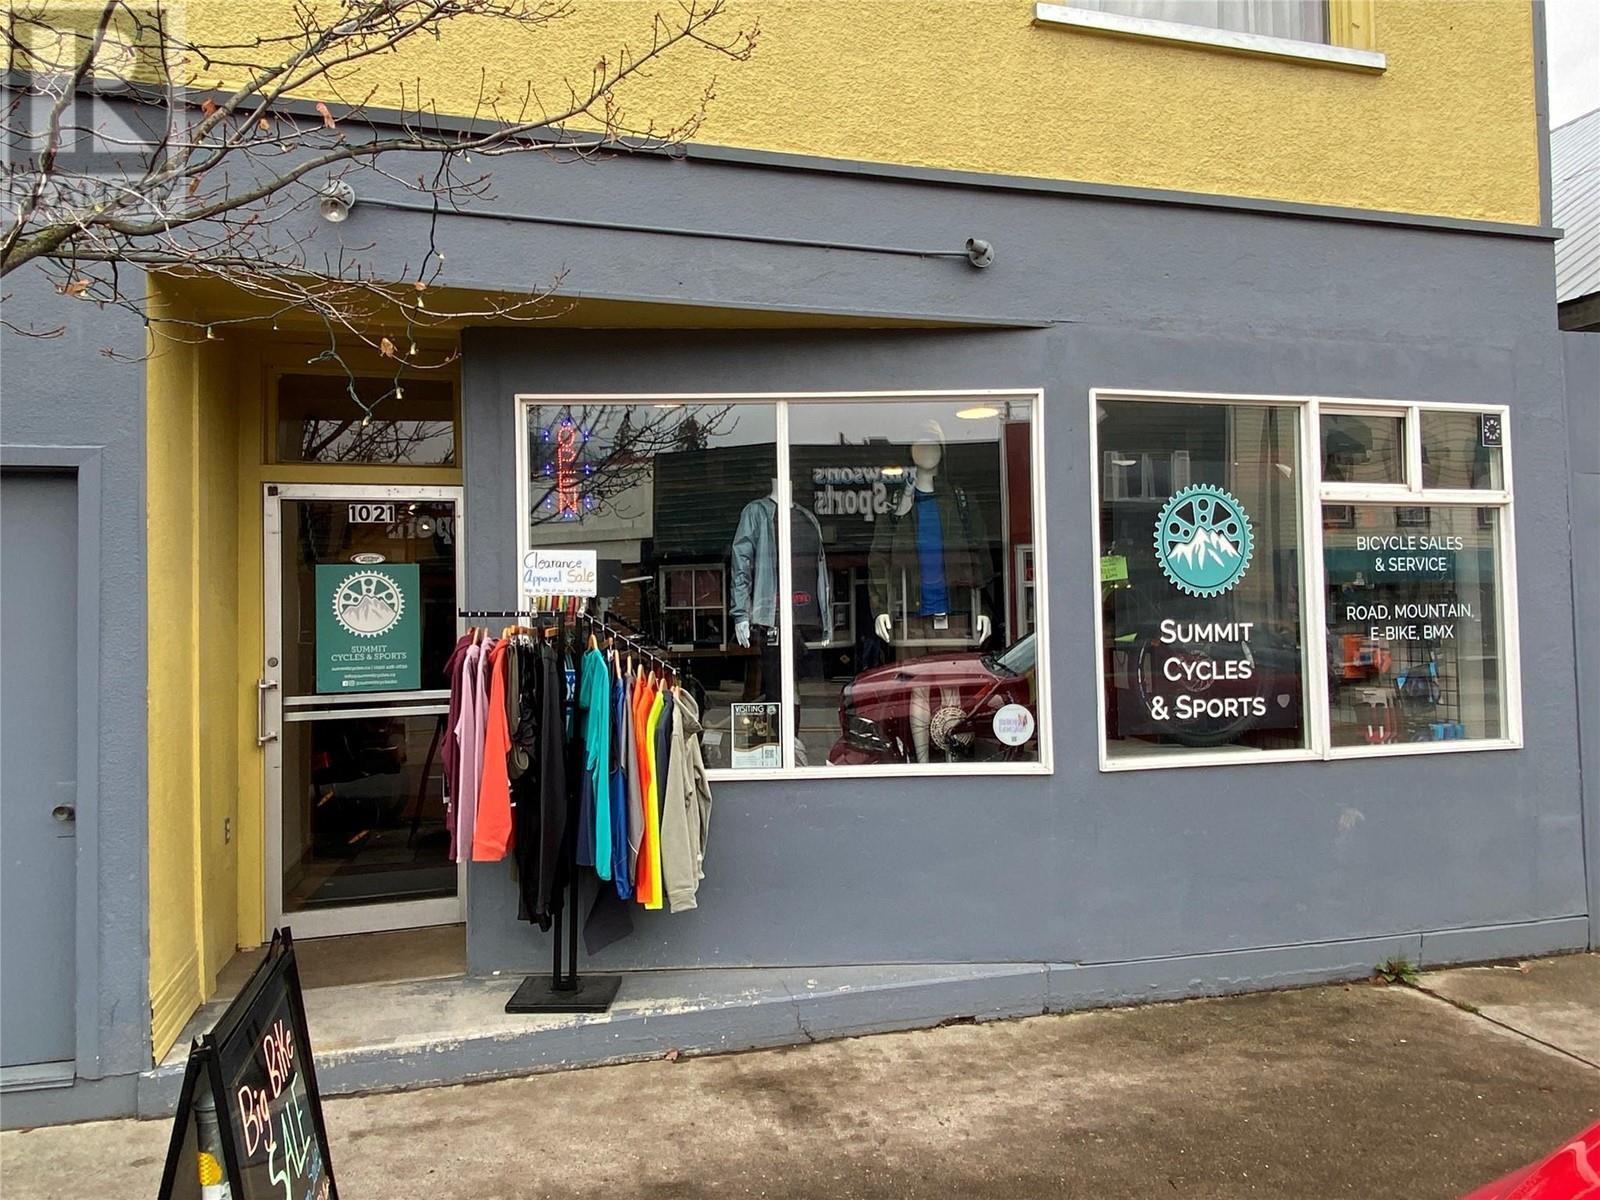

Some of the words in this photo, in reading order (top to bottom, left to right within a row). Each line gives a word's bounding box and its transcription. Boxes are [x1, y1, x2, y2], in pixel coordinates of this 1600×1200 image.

[557, 426, 578, 514] OPEN
[350, 505, 394, 522] 1021
[1356, 536, 1417, 551] BICYCLE
[1420, 536, 1464, 551] SALES
[523, 551, 583, 569] Clearance
[1375, 557, 1386, 572] &
[1388, 557, 1448, 572] SERVICE
[523, 569, 562, 587] Apparel
[566, 567, 595, 584] Sale
[1346, 605, 1392, 621] ROAD,
[1394, 603, 1475, 619] MOUNTAIN,
[1370, 625, 1420, 641] E-BIKE,
[1423, 625, 1455, 640] BMX
[330, 653, 365, 662] CYCLES
[374, 651, 407, 661] SPORTS
[351, 645, 387, 654] SUMMIT
[735, 705, 765, 713] VISITING
[1151, 695, 1170, 721] &
[238, 1085, 276, 1158] Big
[268, 1071, 311, 1200] SALE
